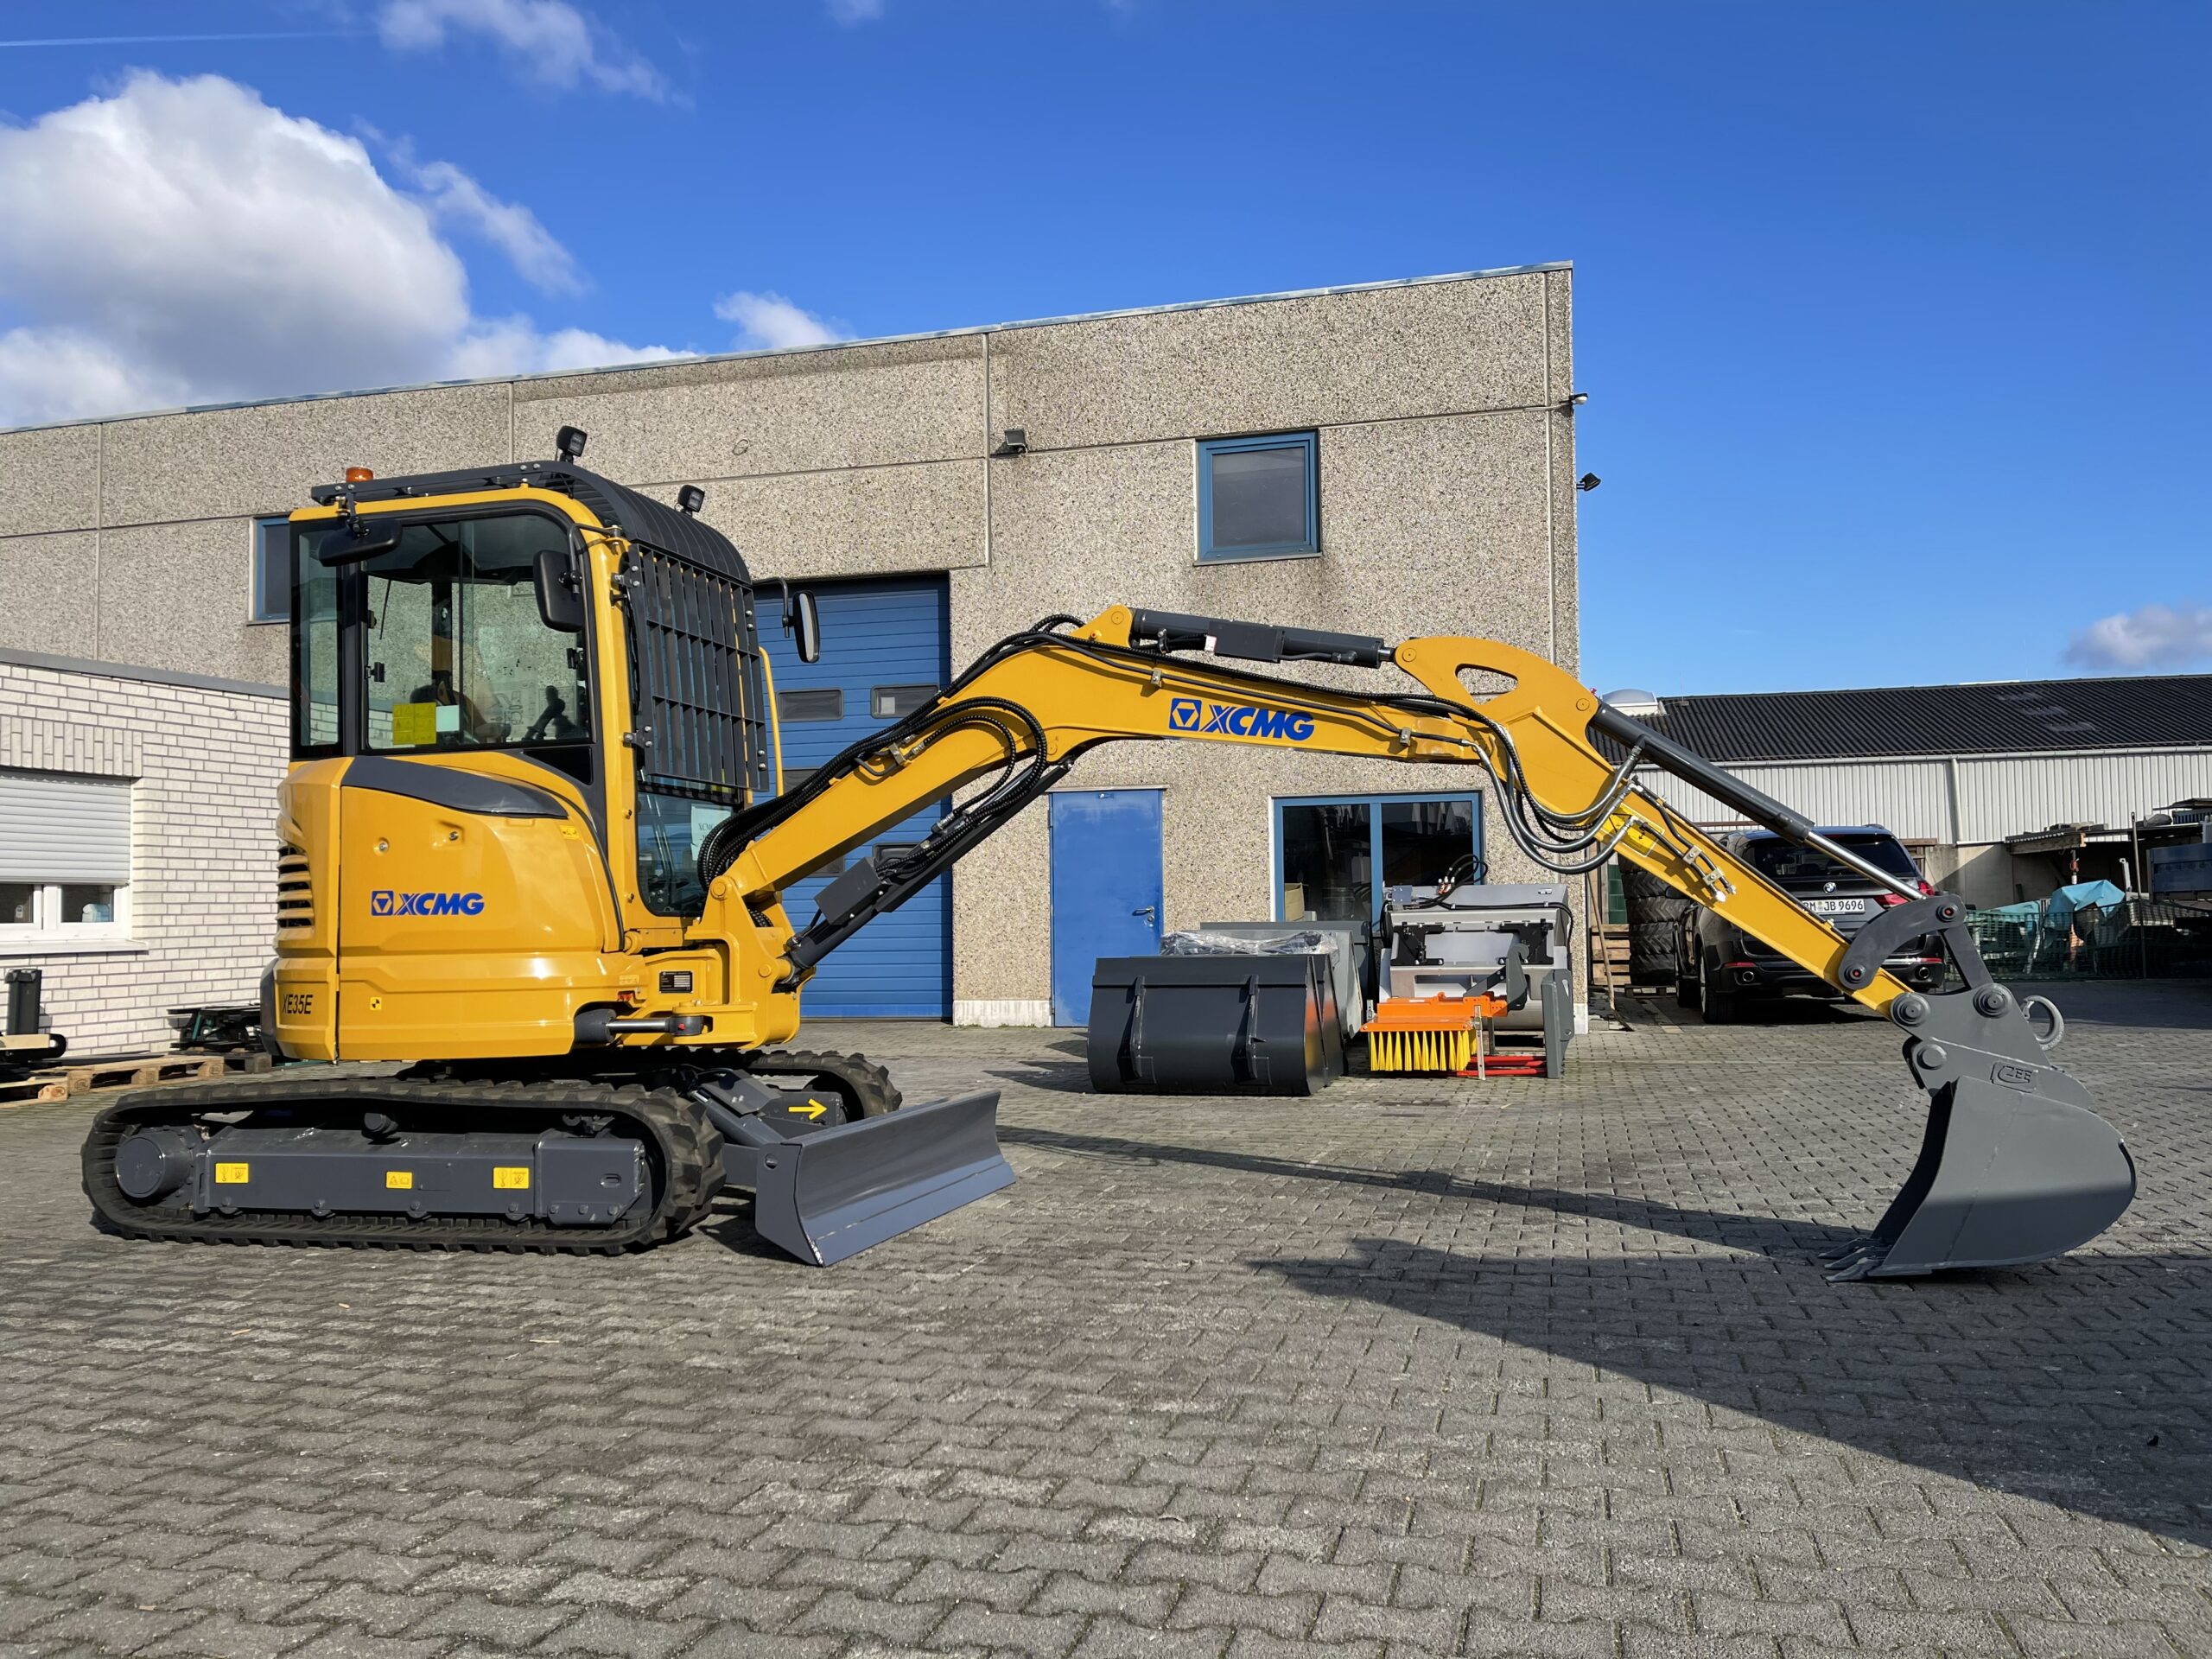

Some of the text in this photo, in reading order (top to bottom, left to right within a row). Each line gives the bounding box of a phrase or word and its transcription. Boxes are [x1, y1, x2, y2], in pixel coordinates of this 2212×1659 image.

[1199, 704, 1315, 741] XCMG
[393, 893, 485, 916] XCMG
[1824, 901, 1836, 911] JB
[1839, 900, 1864, 911] 9696
[283, 994, 314, 1014] XE35E
